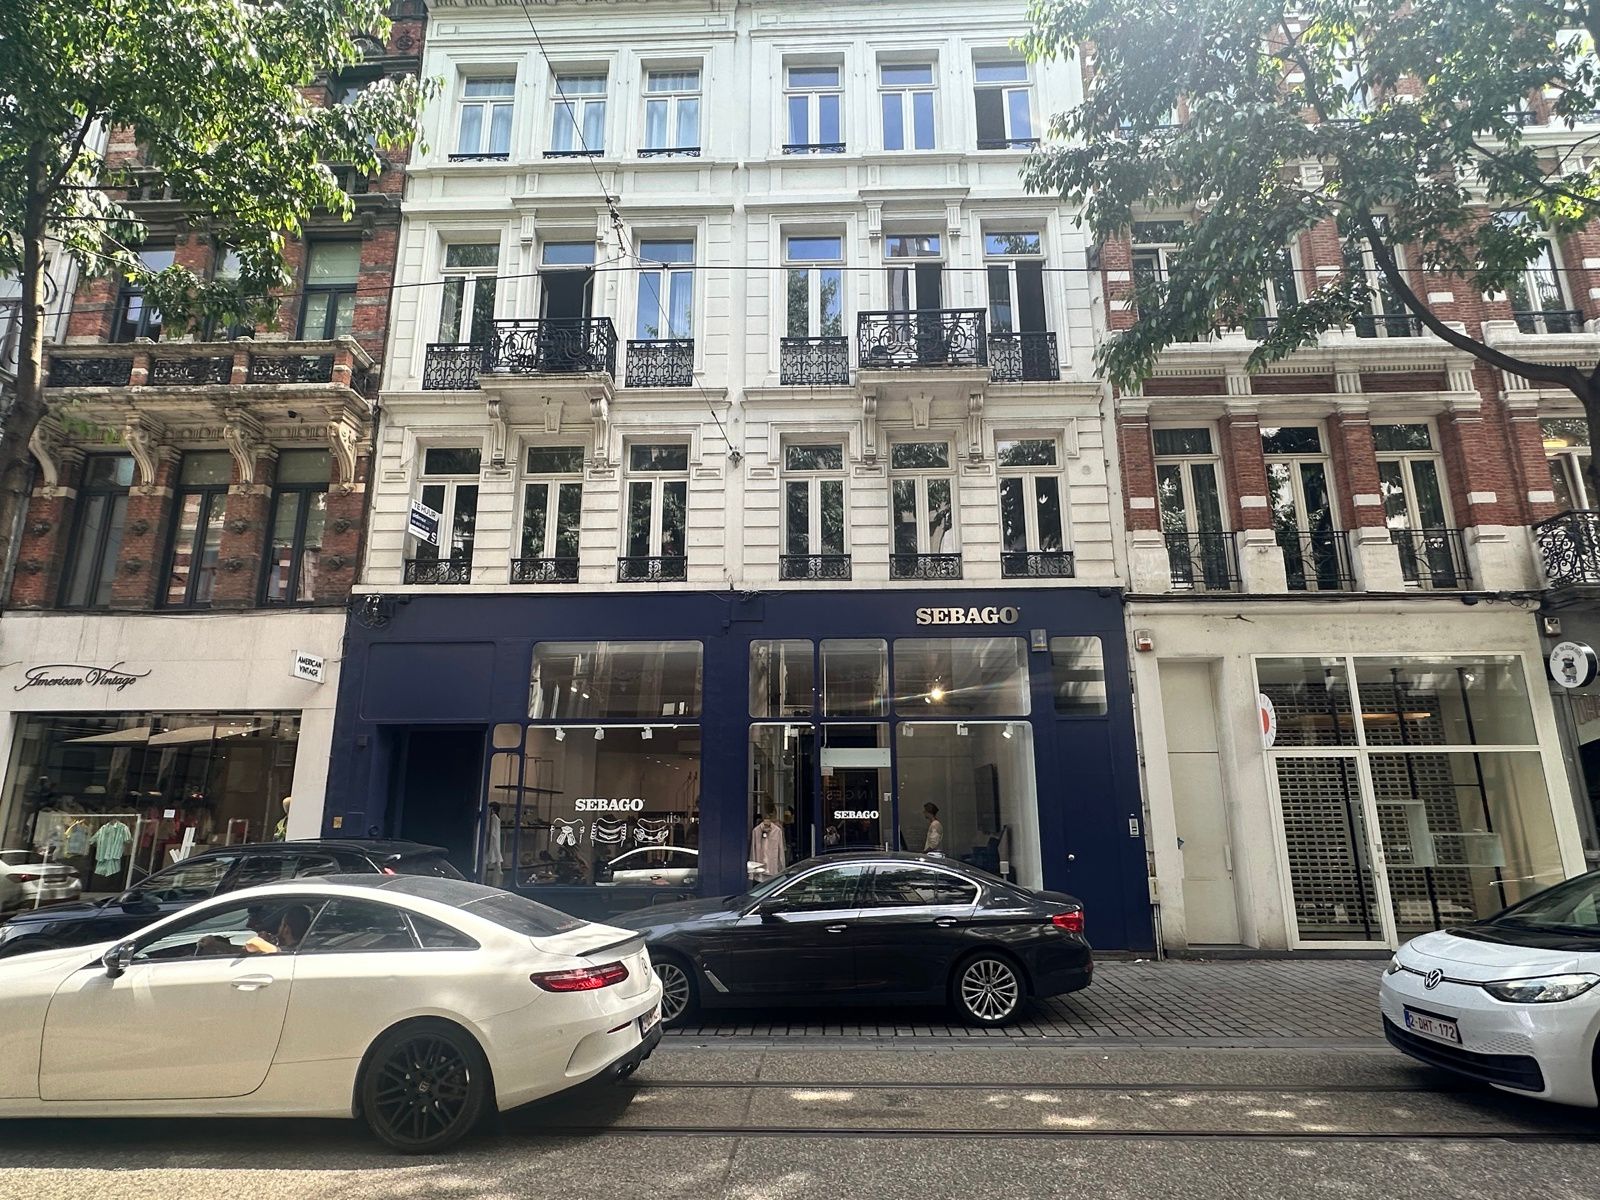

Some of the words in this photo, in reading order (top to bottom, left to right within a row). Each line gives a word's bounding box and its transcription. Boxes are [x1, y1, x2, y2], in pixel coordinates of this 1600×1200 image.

[916, 606, 1019, 625] SEBAGO
[298, 656, 322, 668] AMERICAN
[14, 664, 84, 692] American
[85, 662, 140, 692] Vintage
[299, 665, 319, 677] VINTAGE
[575, 798, 645, 811] SEBAGO
[834, 810, 880, 819] SEBAGO
